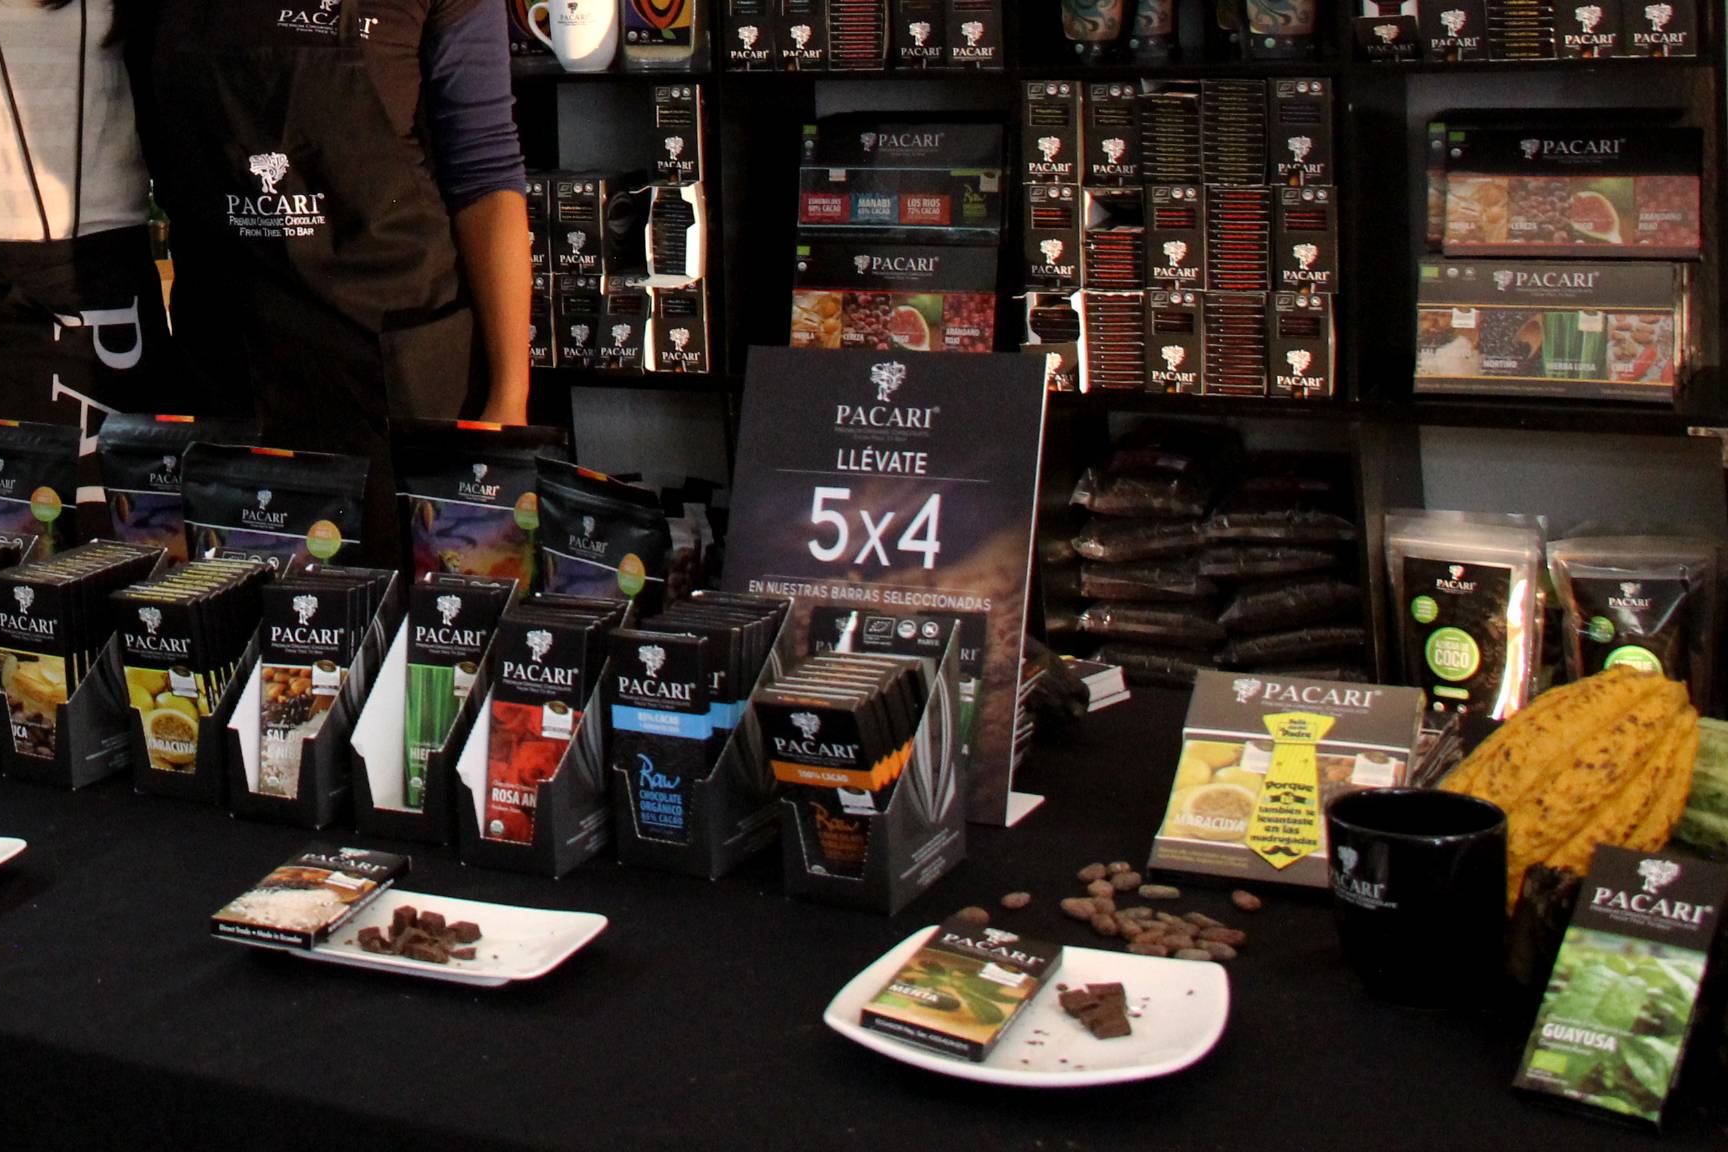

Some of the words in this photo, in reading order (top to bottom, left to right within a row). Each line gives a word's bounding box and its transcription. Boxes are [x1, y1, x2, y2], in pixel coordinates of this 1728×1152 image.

[879, 133, 939, 148] PACARI
[1543, 140, 1620, 155] PACARI
[226, 194, 321, 215] PACARI
[296, 227, 314, 236] BAR
[873, 256, 934, 271] PACARI
[1516, 271, 1594, 288] PACARI
[835, 404, 932, 429] PACARI
[837, 446, 928, 474] LLÉVATE
[808, 487, 941, 569] 5x4
[749, 580, 764, 593] EN
[766, 581, 828, 598] NUESTRAS
[831, 586, 880, 602] BARRAS
[883, 590, 992, 611] SELECCIONADAS
[0, 612, 55, 635] PACARI
[125, 633, 189, 654] PACARI
[272, 626, 340, 645] PACARI
[416, 626, 482, 646] PACARI
[1433, 650, 1470, 667] COCO
[503, 661, 573, 686] PACARI
[619, 676, 691, 700] PACARI
[1263, 682, 1376, 708] PACARI
[774, 737, 856, 759] PACARI
[638, 753, 681, 789] Raw
[492, 787, 520, 805] ROSA
[640, 789, 683, 805] CHOCOLATE
[1592, 887, 1708, 924] PACARI
[943, 933, 1037, 967] PACARI
[889, 984, 939, 1002] MENTA
[1542, 1022, 1617, 1052] GUAYUSA
